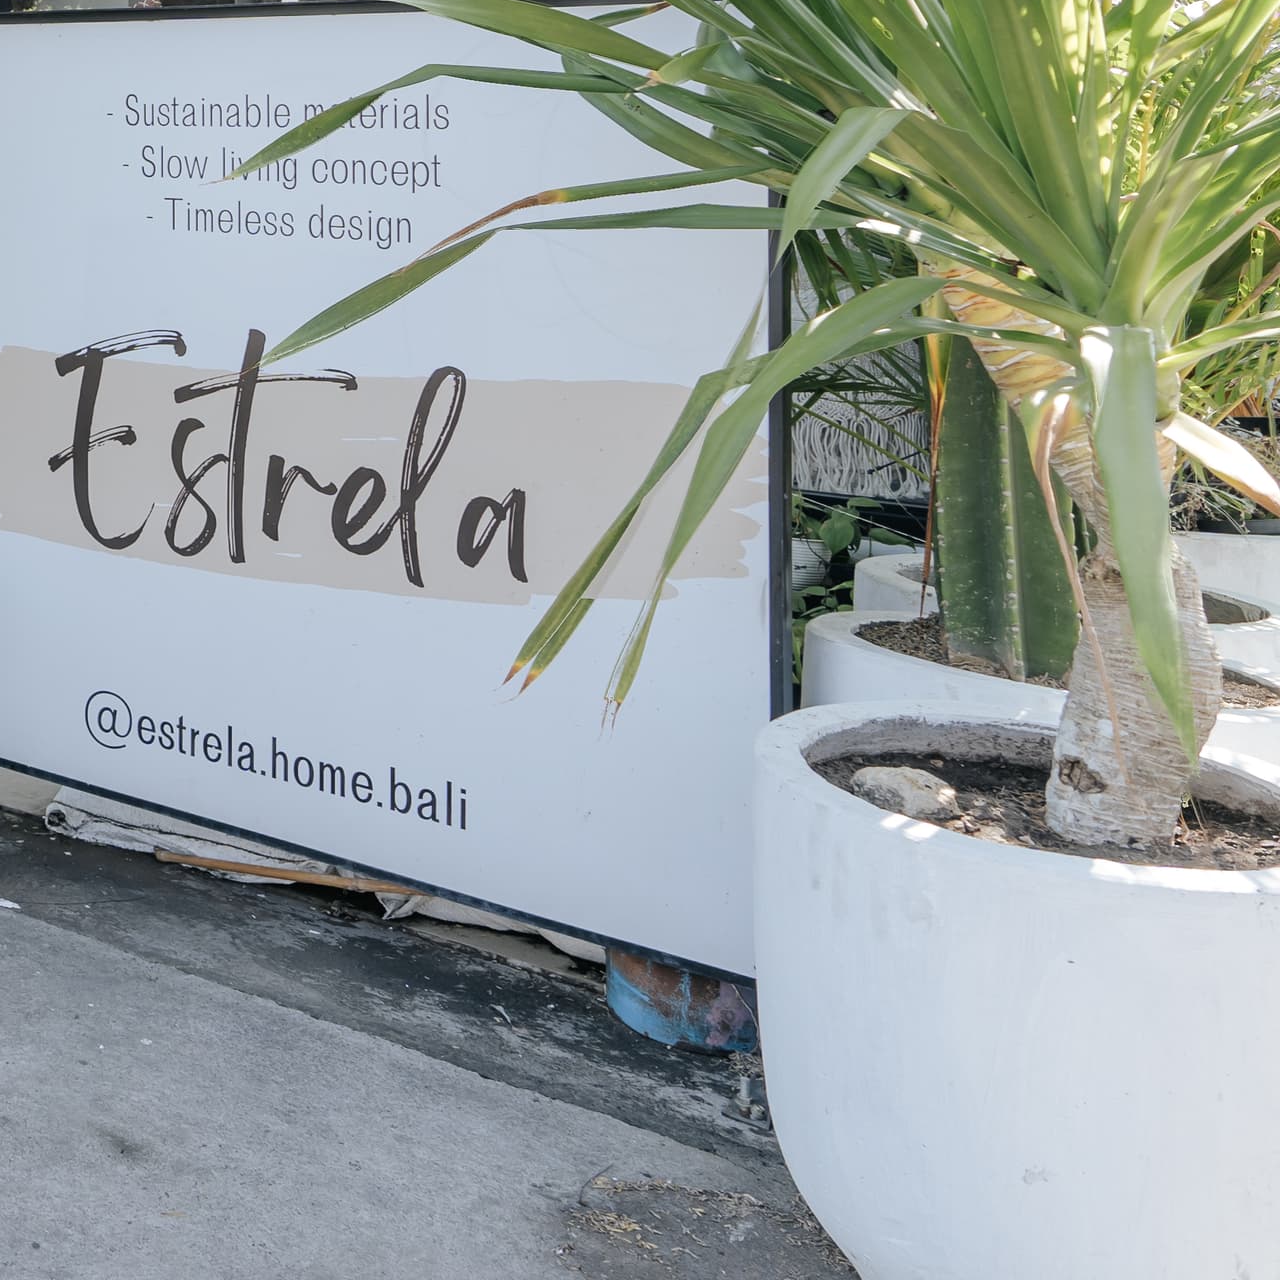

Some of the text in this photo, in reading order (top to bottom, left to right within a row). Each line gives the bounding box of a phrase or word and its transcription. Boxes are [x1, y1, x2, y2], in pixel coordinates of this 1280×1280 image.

[124, 93, 291, 128] Sustainable
[303, 94, 450, 130] merials
[140, 144, 209, 180] Slow
[311, 154, 441, 194] concept
[163, 197, 295, 237] Timeless
[308, 204, 412, 250] design
[47, 328, 528, 588] Estrela
[84, 690, 468, 830] @estrela.home.bali
